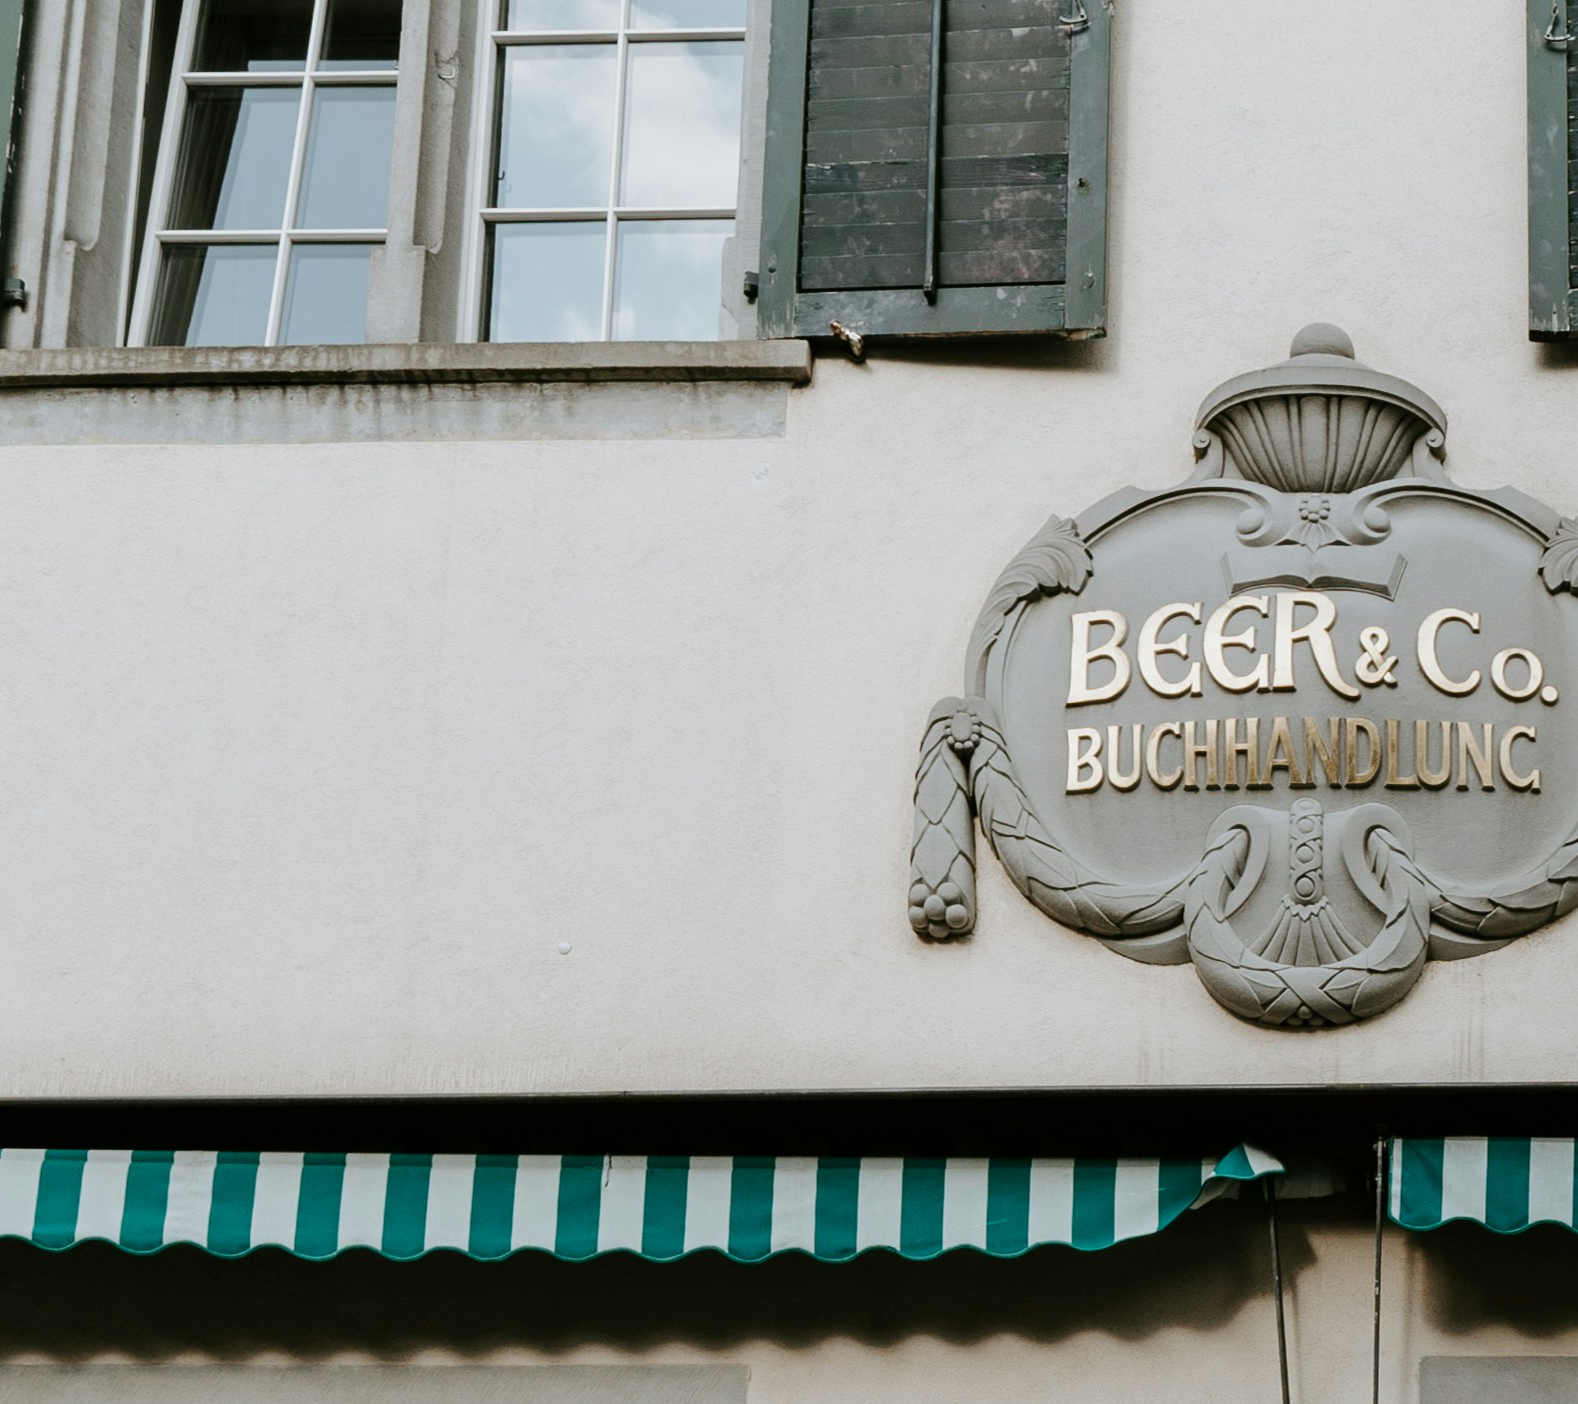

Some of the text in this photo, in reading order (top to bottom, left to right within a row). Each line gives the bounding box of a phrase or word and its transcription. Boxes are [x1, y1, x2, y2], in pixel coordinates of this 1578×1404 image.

[1065, 590, 1559, 707] BEER & Co.
[1065, 716, 1542, 795] BUCHHANDLUNG
